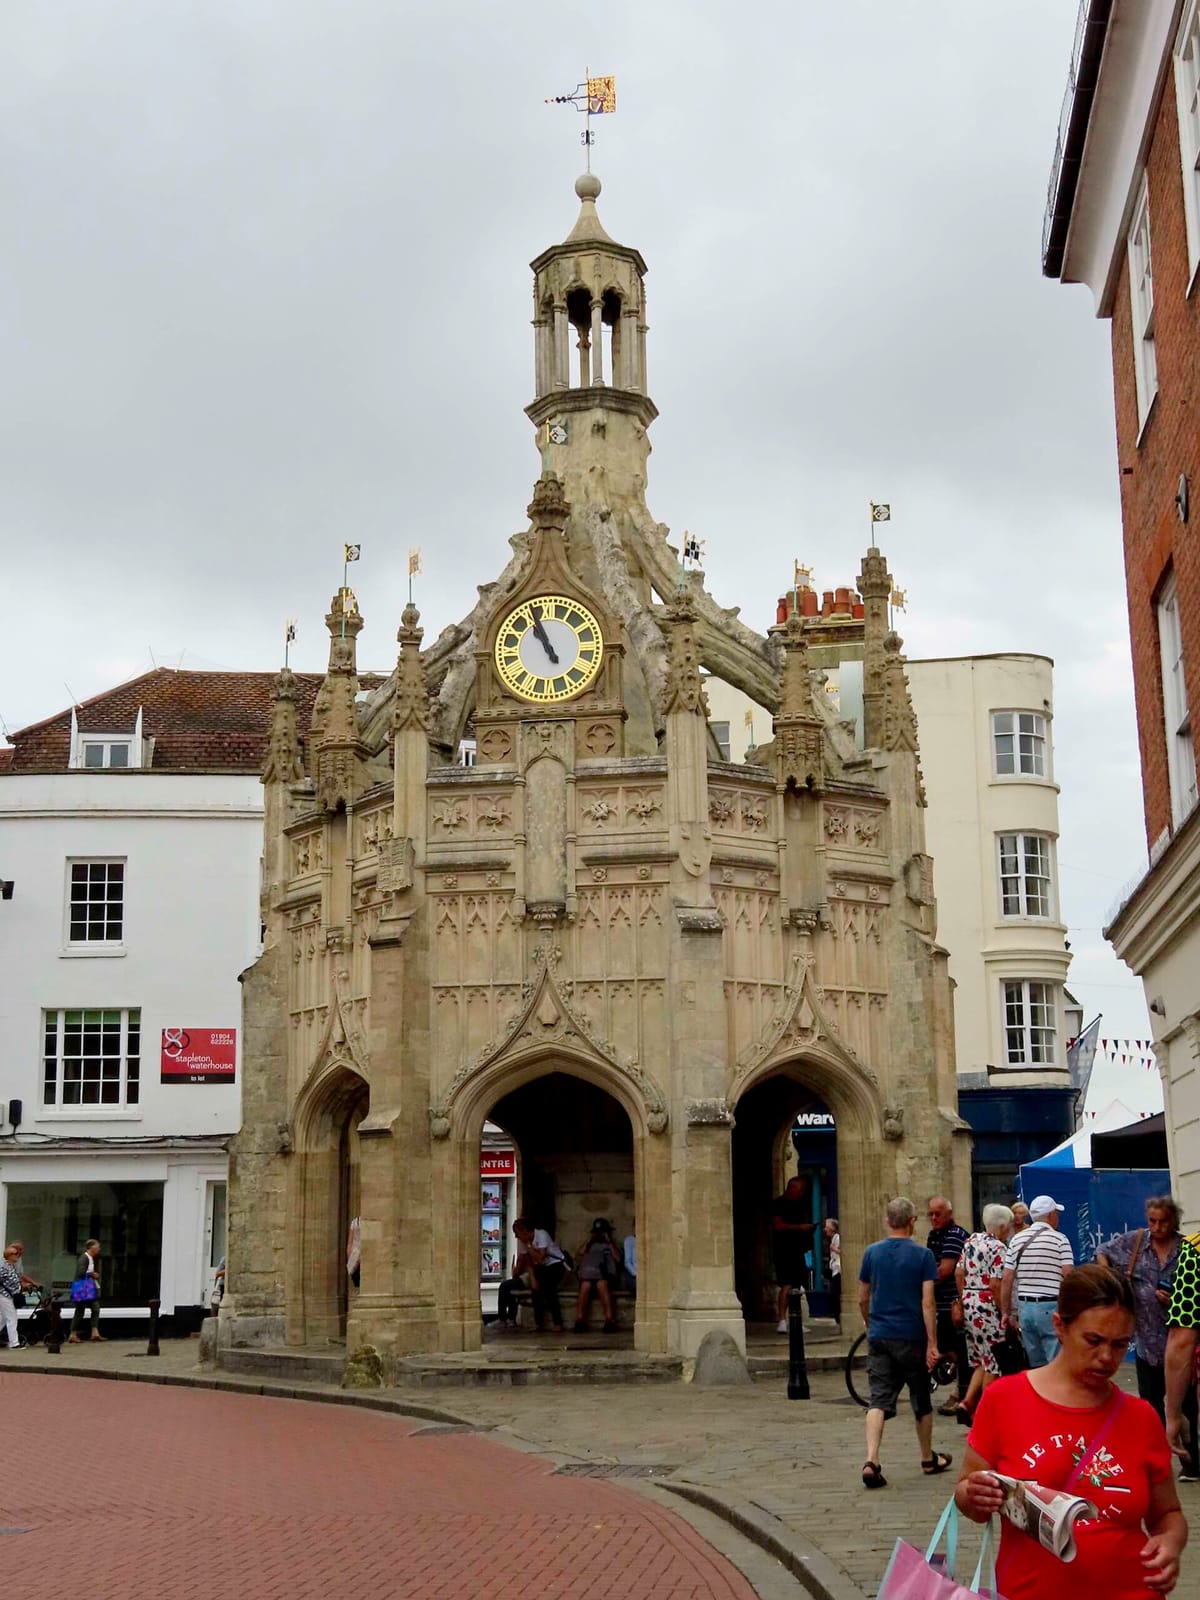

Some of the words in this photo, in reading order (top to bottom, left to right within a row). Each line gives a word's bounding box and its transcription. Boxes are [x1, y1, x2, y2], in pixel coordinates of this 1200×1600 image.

[175, 1051, 211, 1067] stapleton
[189, 1059, 234, 1070] waterhouse
[1022, 1442, 1046, 1469] JE
